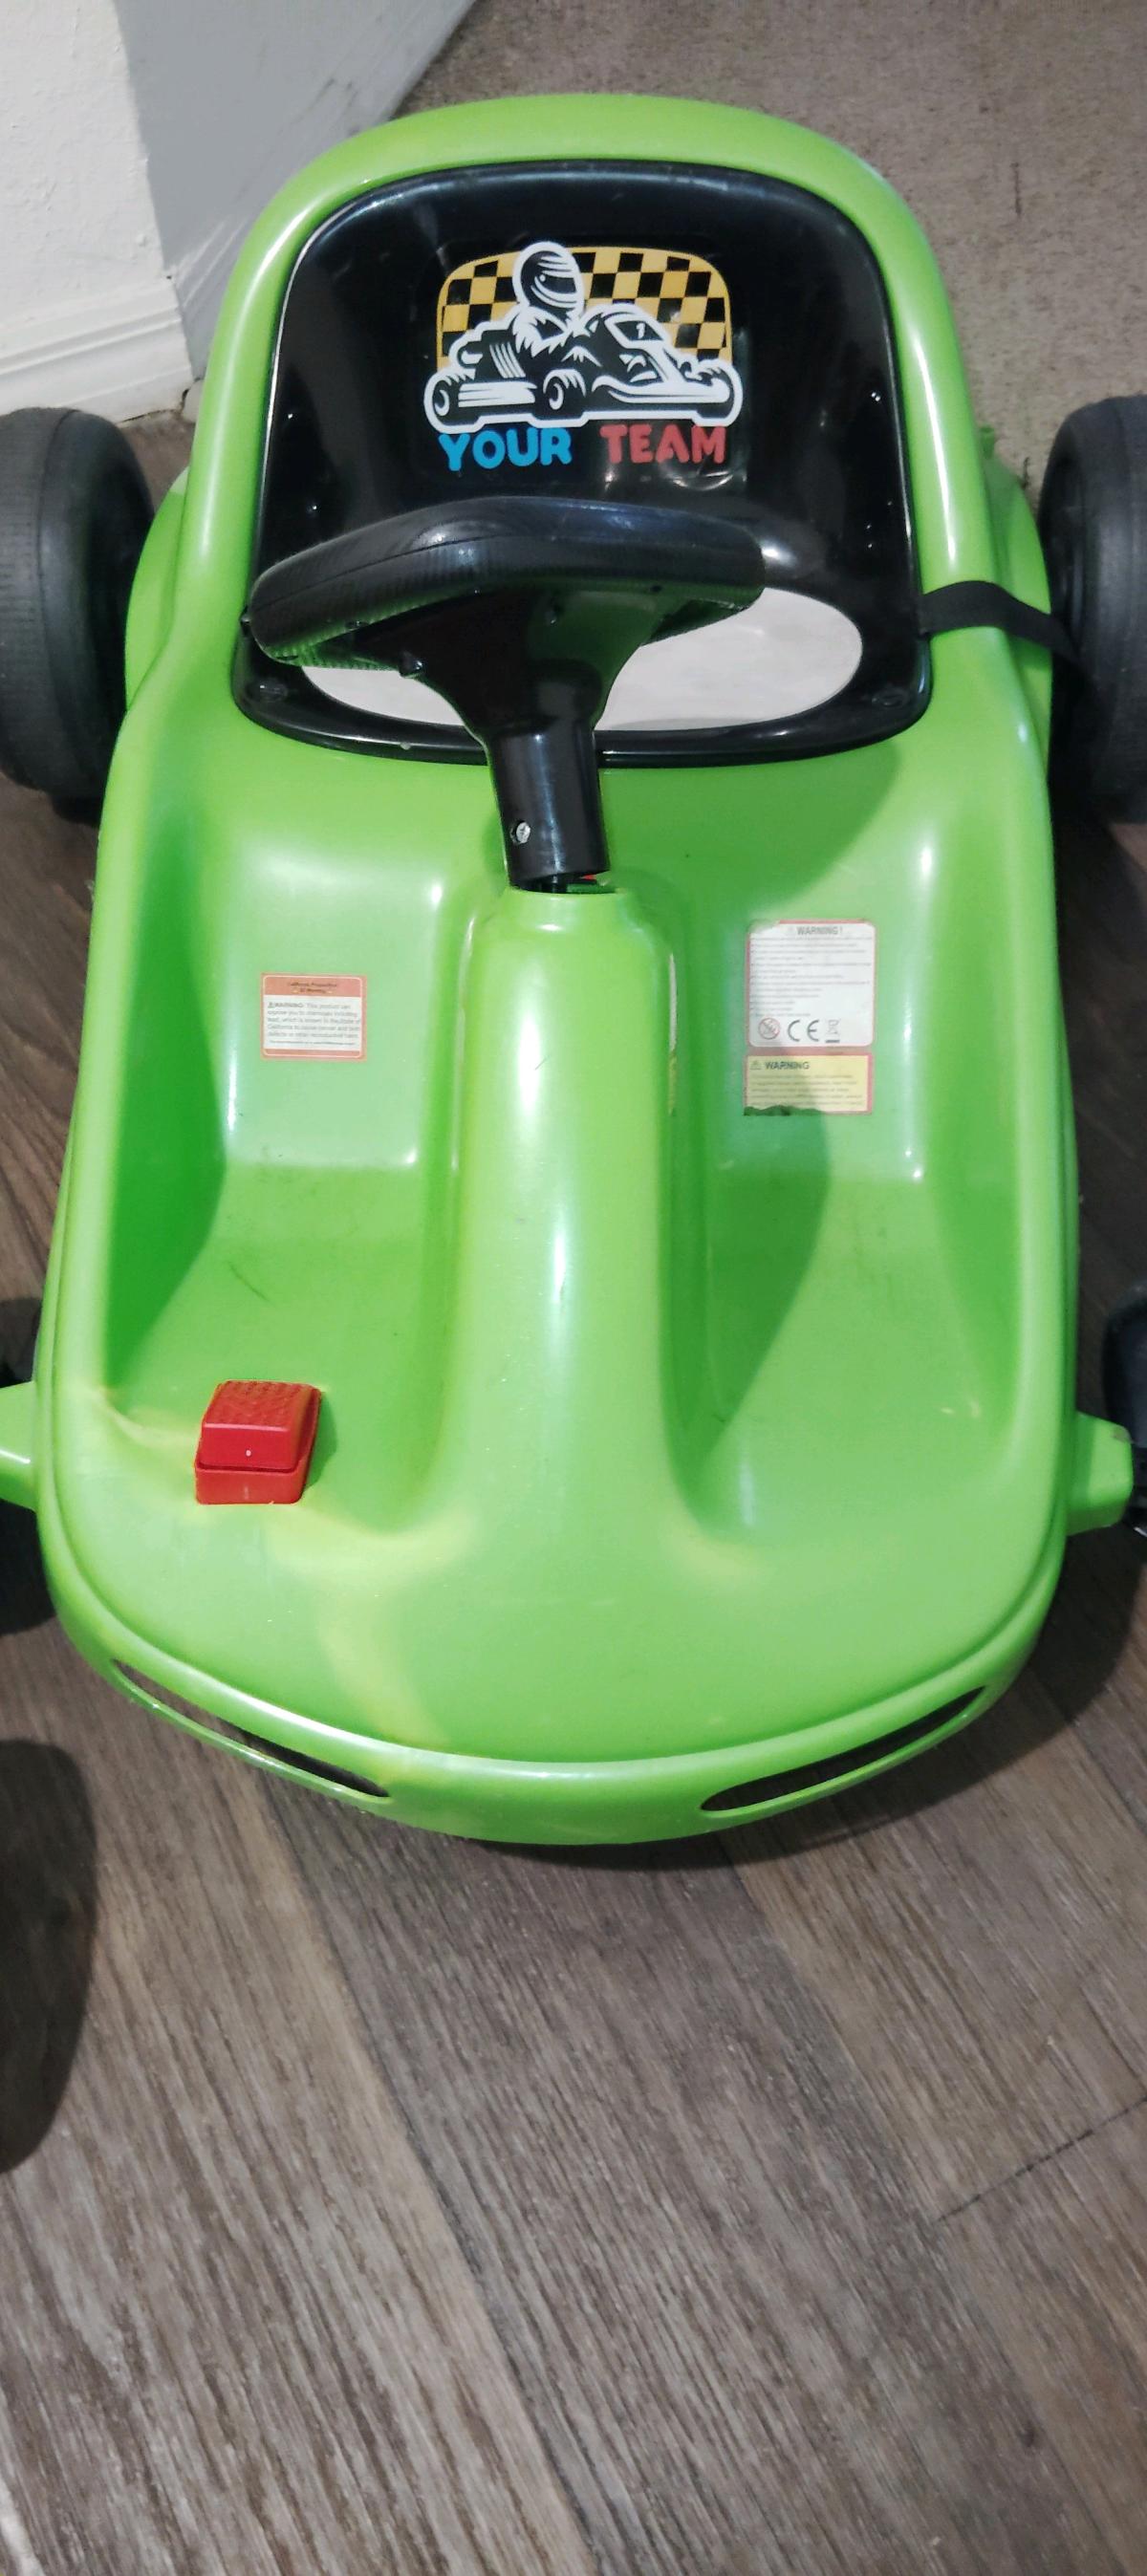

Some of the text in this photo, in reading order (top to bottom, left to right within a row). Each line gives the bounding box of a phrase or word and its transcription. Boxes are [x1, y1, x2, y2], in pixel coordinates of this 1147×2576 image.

[438, 424, 727, 471] YOUR TEAM
[797, 926, 838, 936] WARNING
[788, 1020, 819, 1042] CE
[765, 1061, 810, 1070] WARNING
